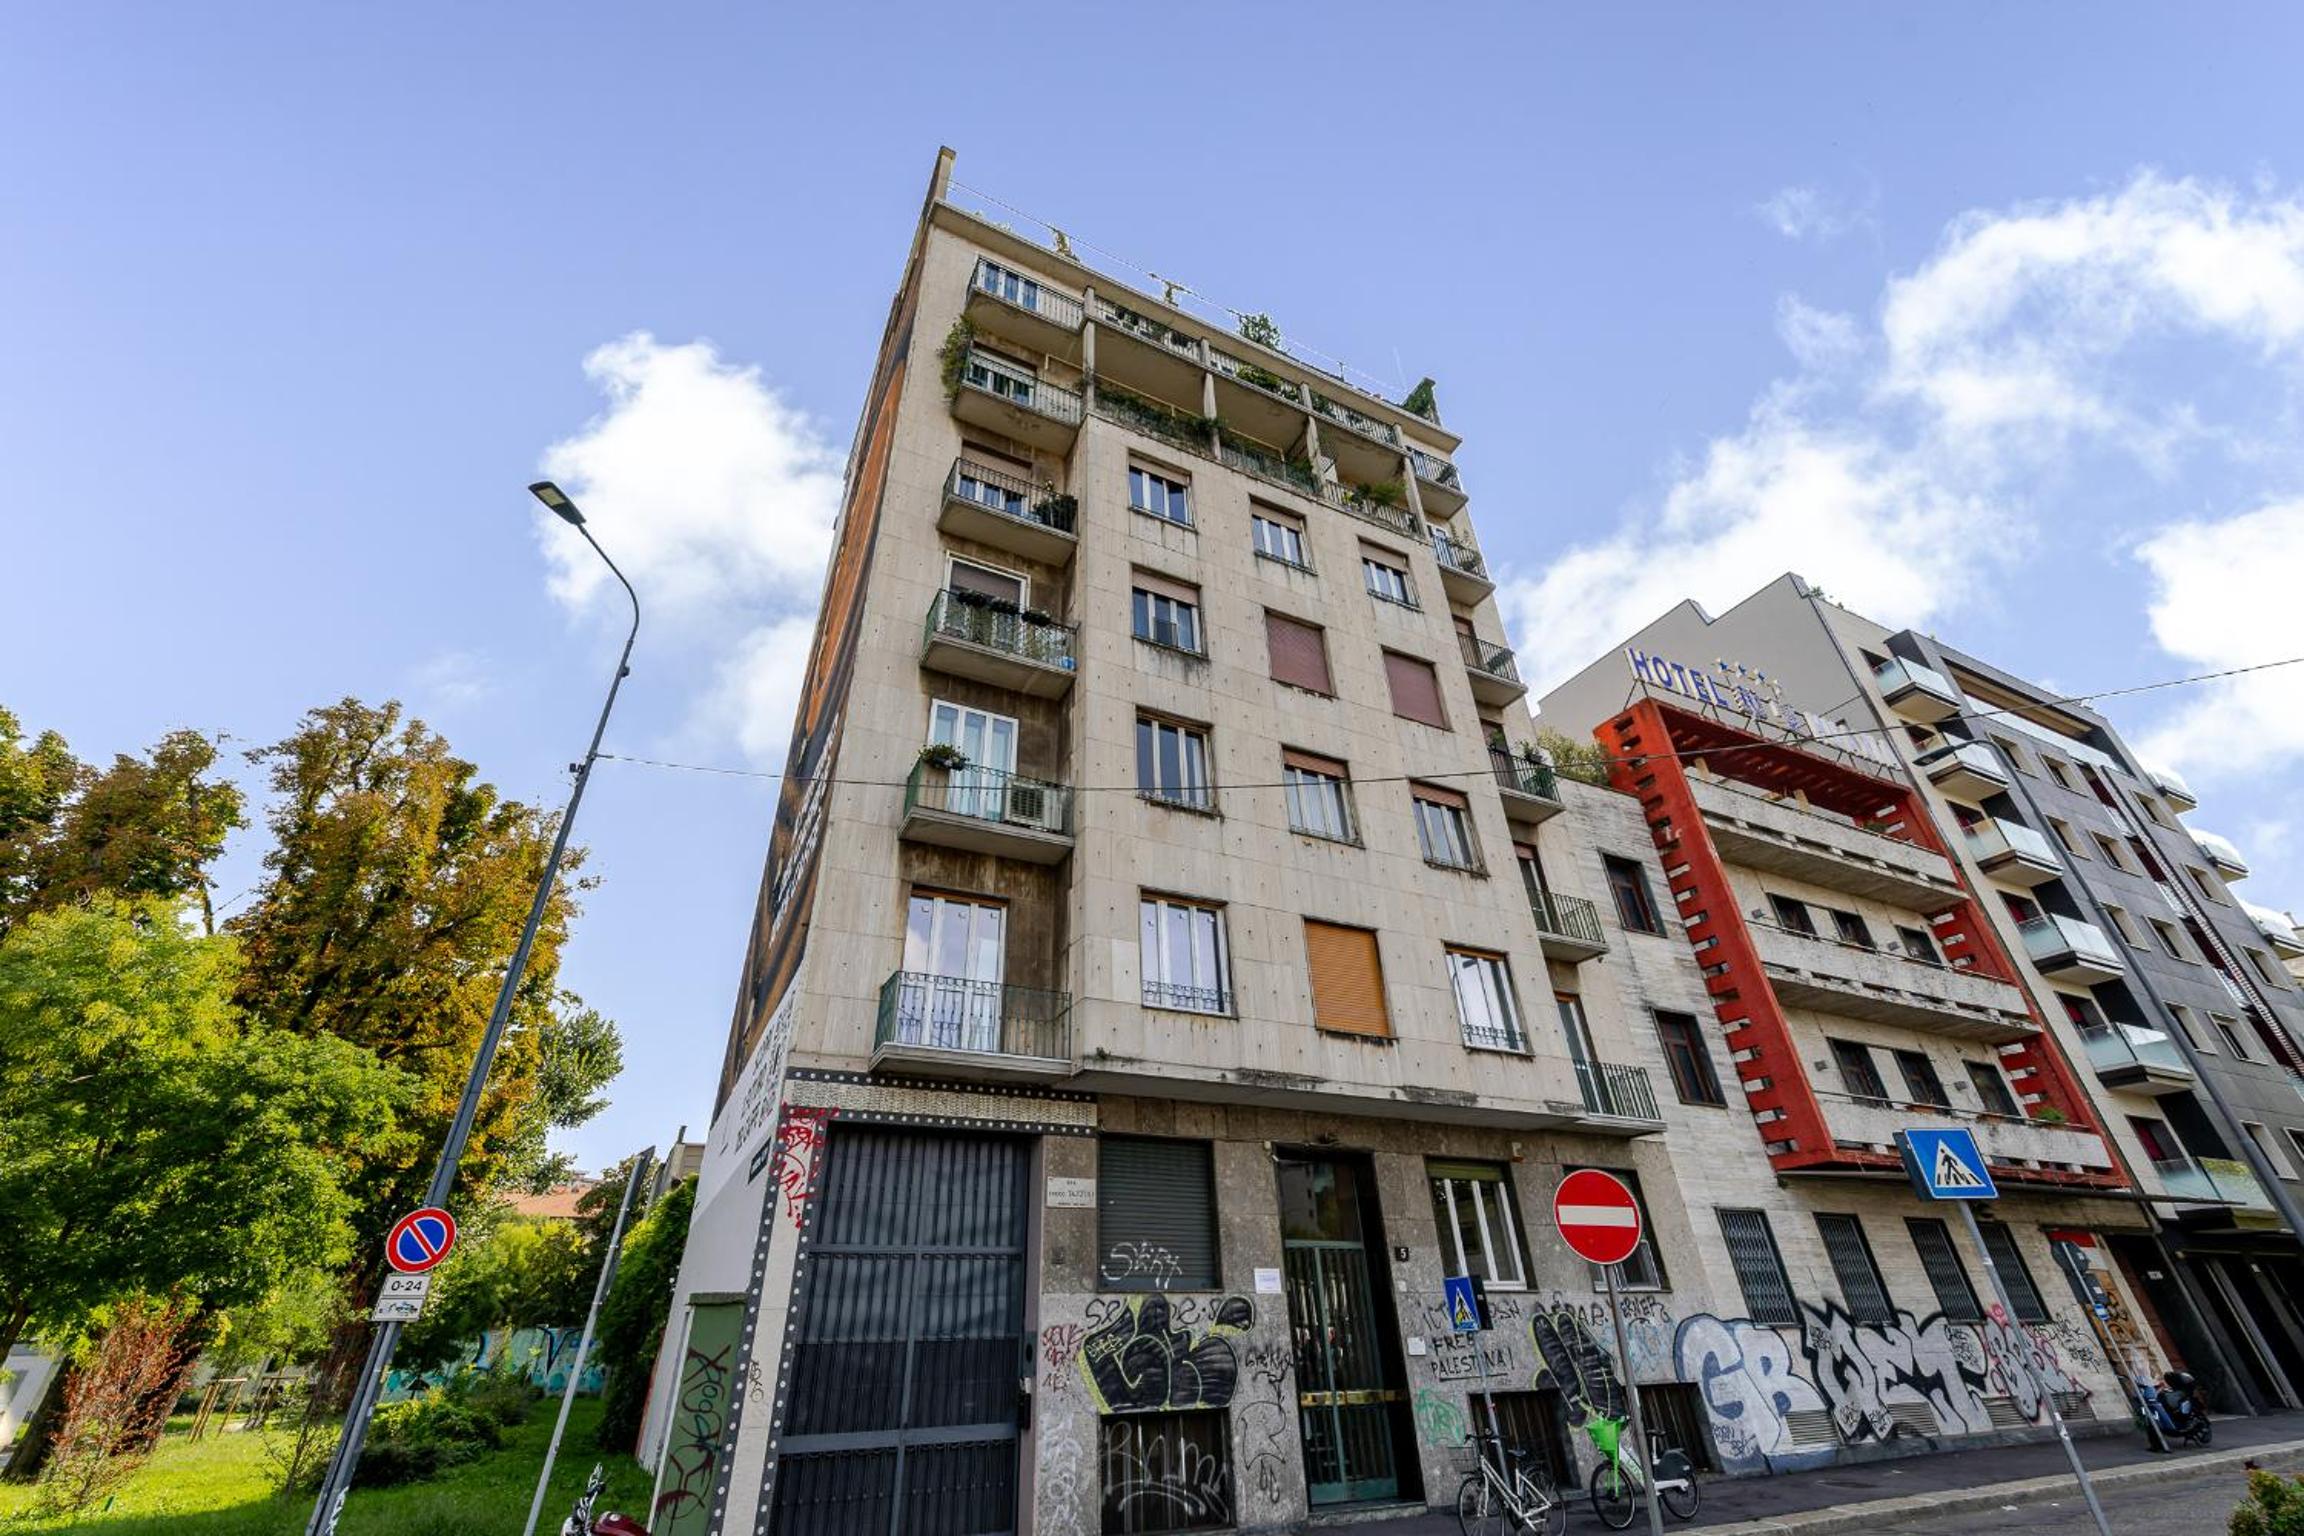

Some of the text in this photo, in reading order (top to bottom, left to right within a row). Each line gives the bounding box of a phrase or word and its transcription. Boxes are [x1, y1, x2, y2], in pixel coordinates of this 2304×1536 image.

[1624, 647, 1729, 707] HOTEL
[1400, 1248, 1407, 1259] 5
[391, 1281, 422, 1291] 0-24
[1430, 1347, 1515, 1377] PALESTNA!
